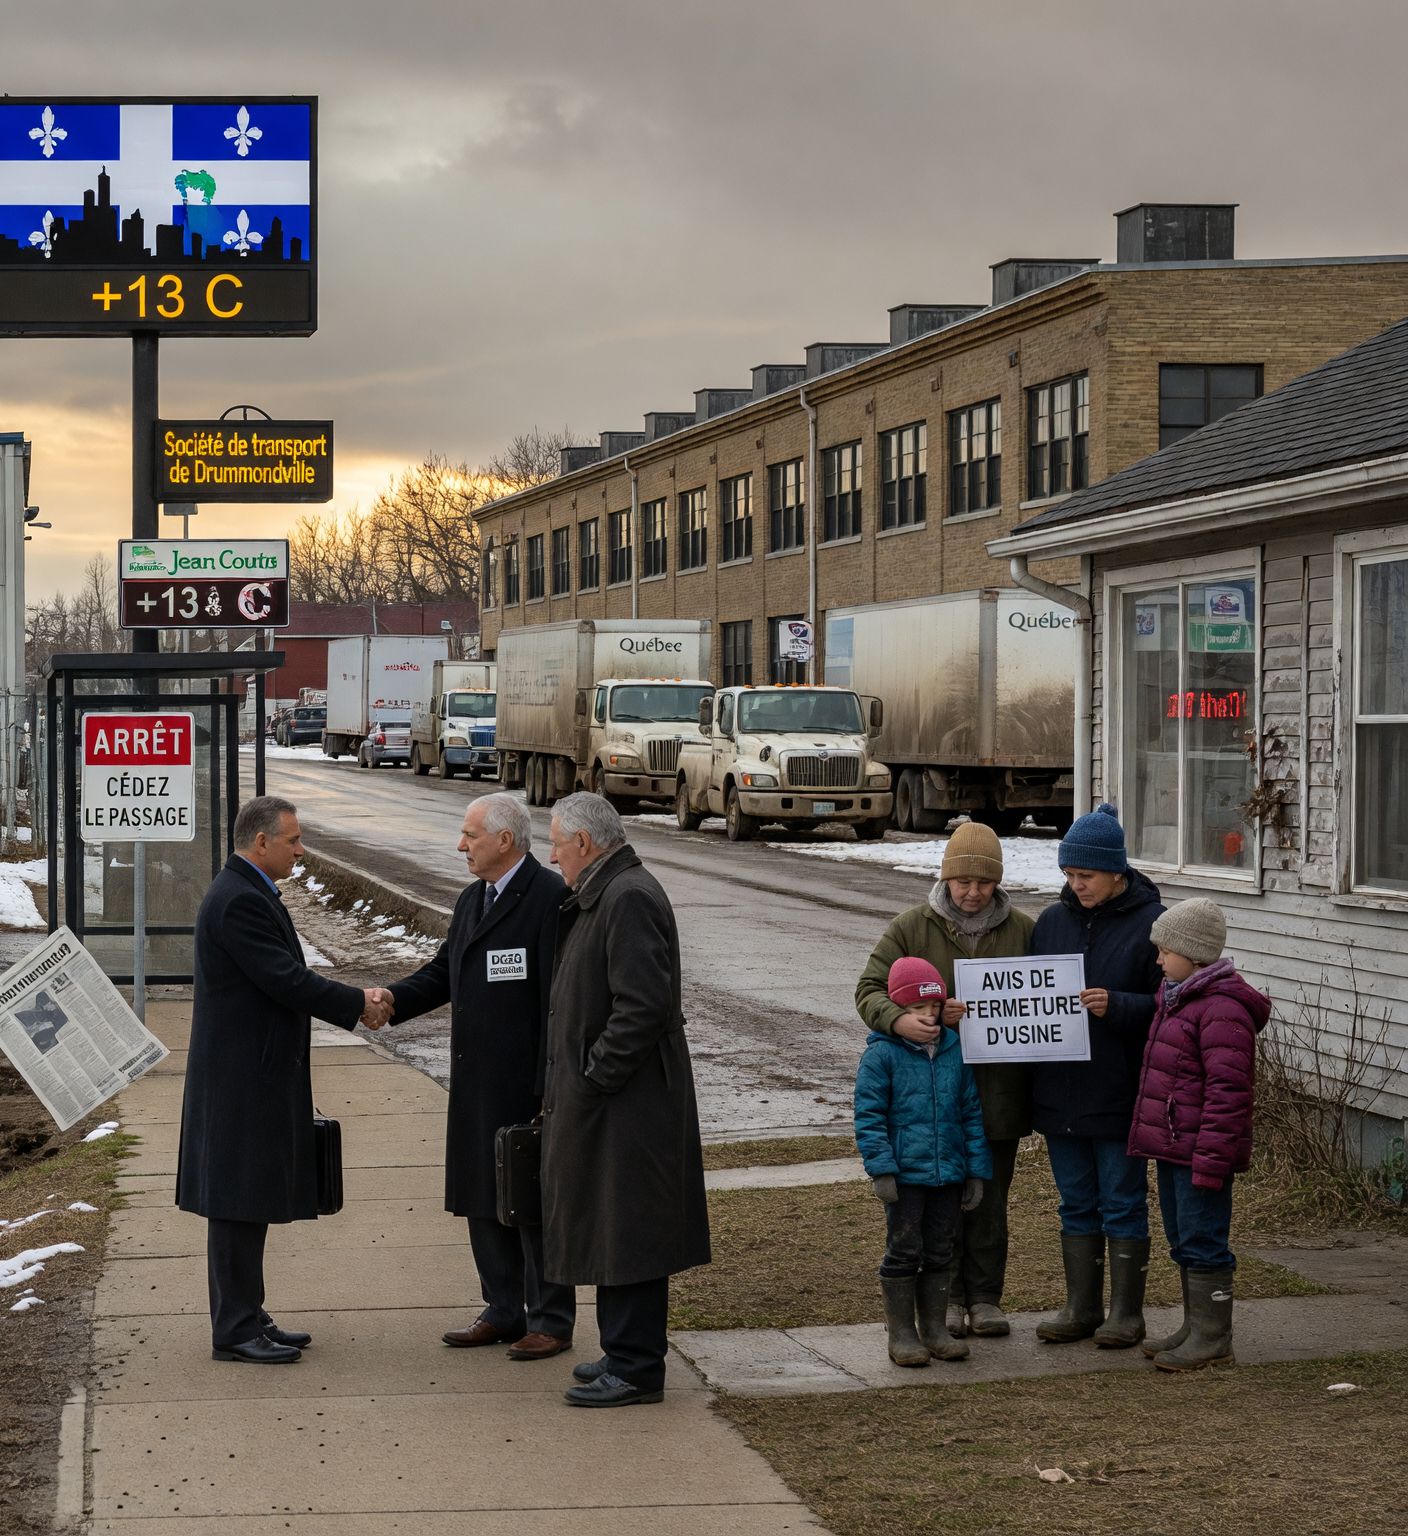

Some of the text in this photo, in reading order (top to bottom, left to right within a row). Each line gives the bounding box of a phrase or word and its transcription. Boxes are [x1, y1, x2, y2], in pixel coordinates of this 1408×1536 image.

[92, 274, 244, 318] +13 C
[164, 431, 327, 463] Société de transport
[169, 459, 315, 484] de Drummondville
[167, 550, 216, 576] Jean
[136, 586, 199, 619] +13
[619, 637, 683, 655] Québec
[93, 720, 184, 755] ARRÊT
[106, 772, 170, 797] CÉDEZ
[85, 807, 188, 827] LE PASSAGE
[982, 969, 1056, 991] AVIS DE
[966, 995, 1082, 1019] FERMETURE
[987, 1023, 1063, 1046] D'USINE
